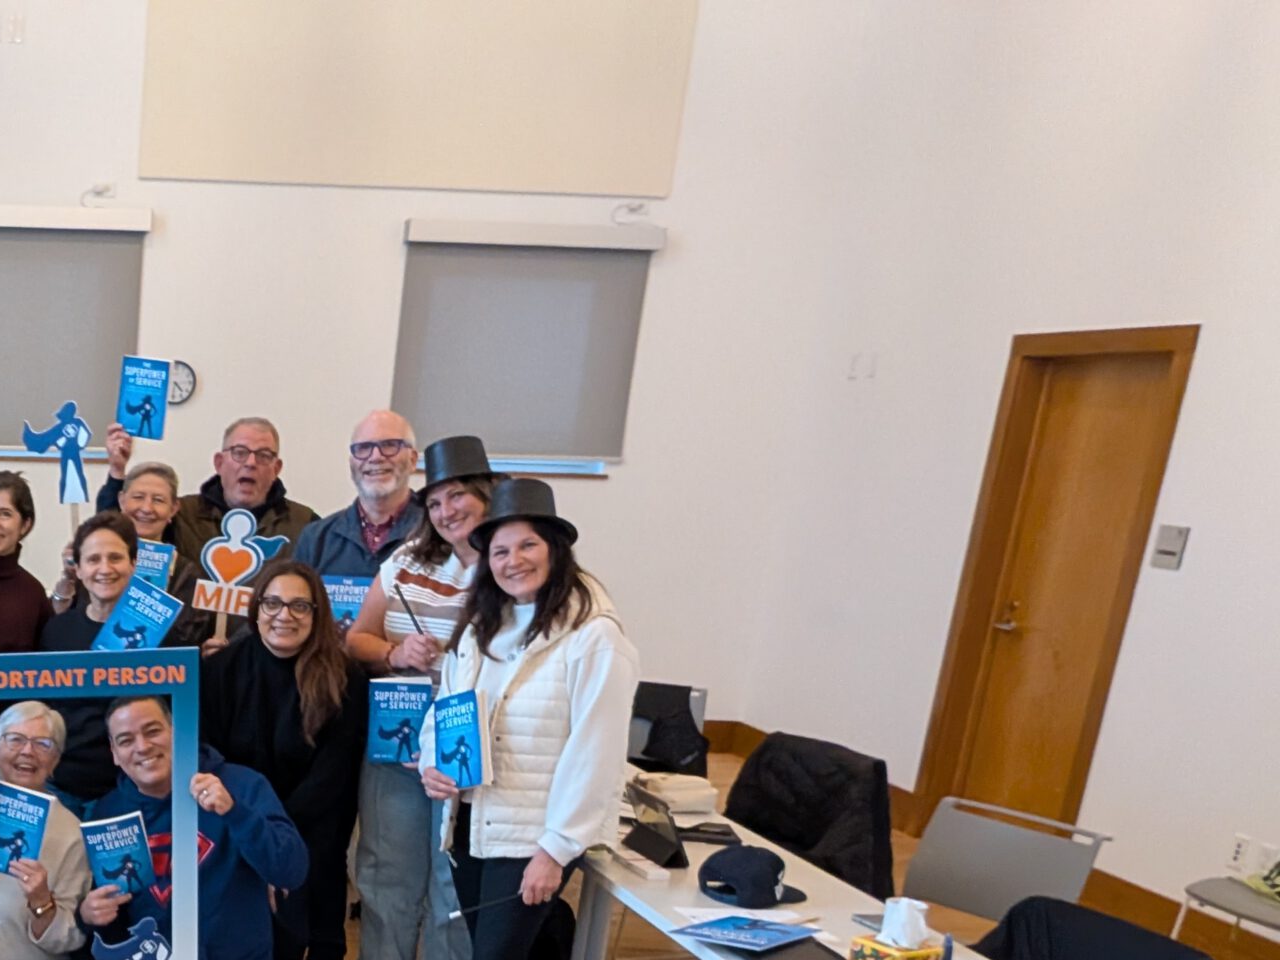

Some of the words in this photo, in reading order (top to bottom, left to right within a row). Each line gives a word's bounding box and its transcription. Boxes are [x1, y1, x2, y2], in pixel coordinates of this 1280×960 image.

[127, 586, 173, 618] SUPERPOWER
[135, 602, 166, 625] SERVICE
[93, 665, 186, 686] PERSON
[374, 690, 428, 703] SUPERPOWER
[388, 700, 423, 710] SERVICE
[435, 701, 474, 722] SUPERPOWER
[445, 713, 473, 729] SERVICE
[7, 807, 39, 825] SERVICE
[86, 824, 140, 845] SUPERPOWER
[103, 835, 138, 851] SERVICE
